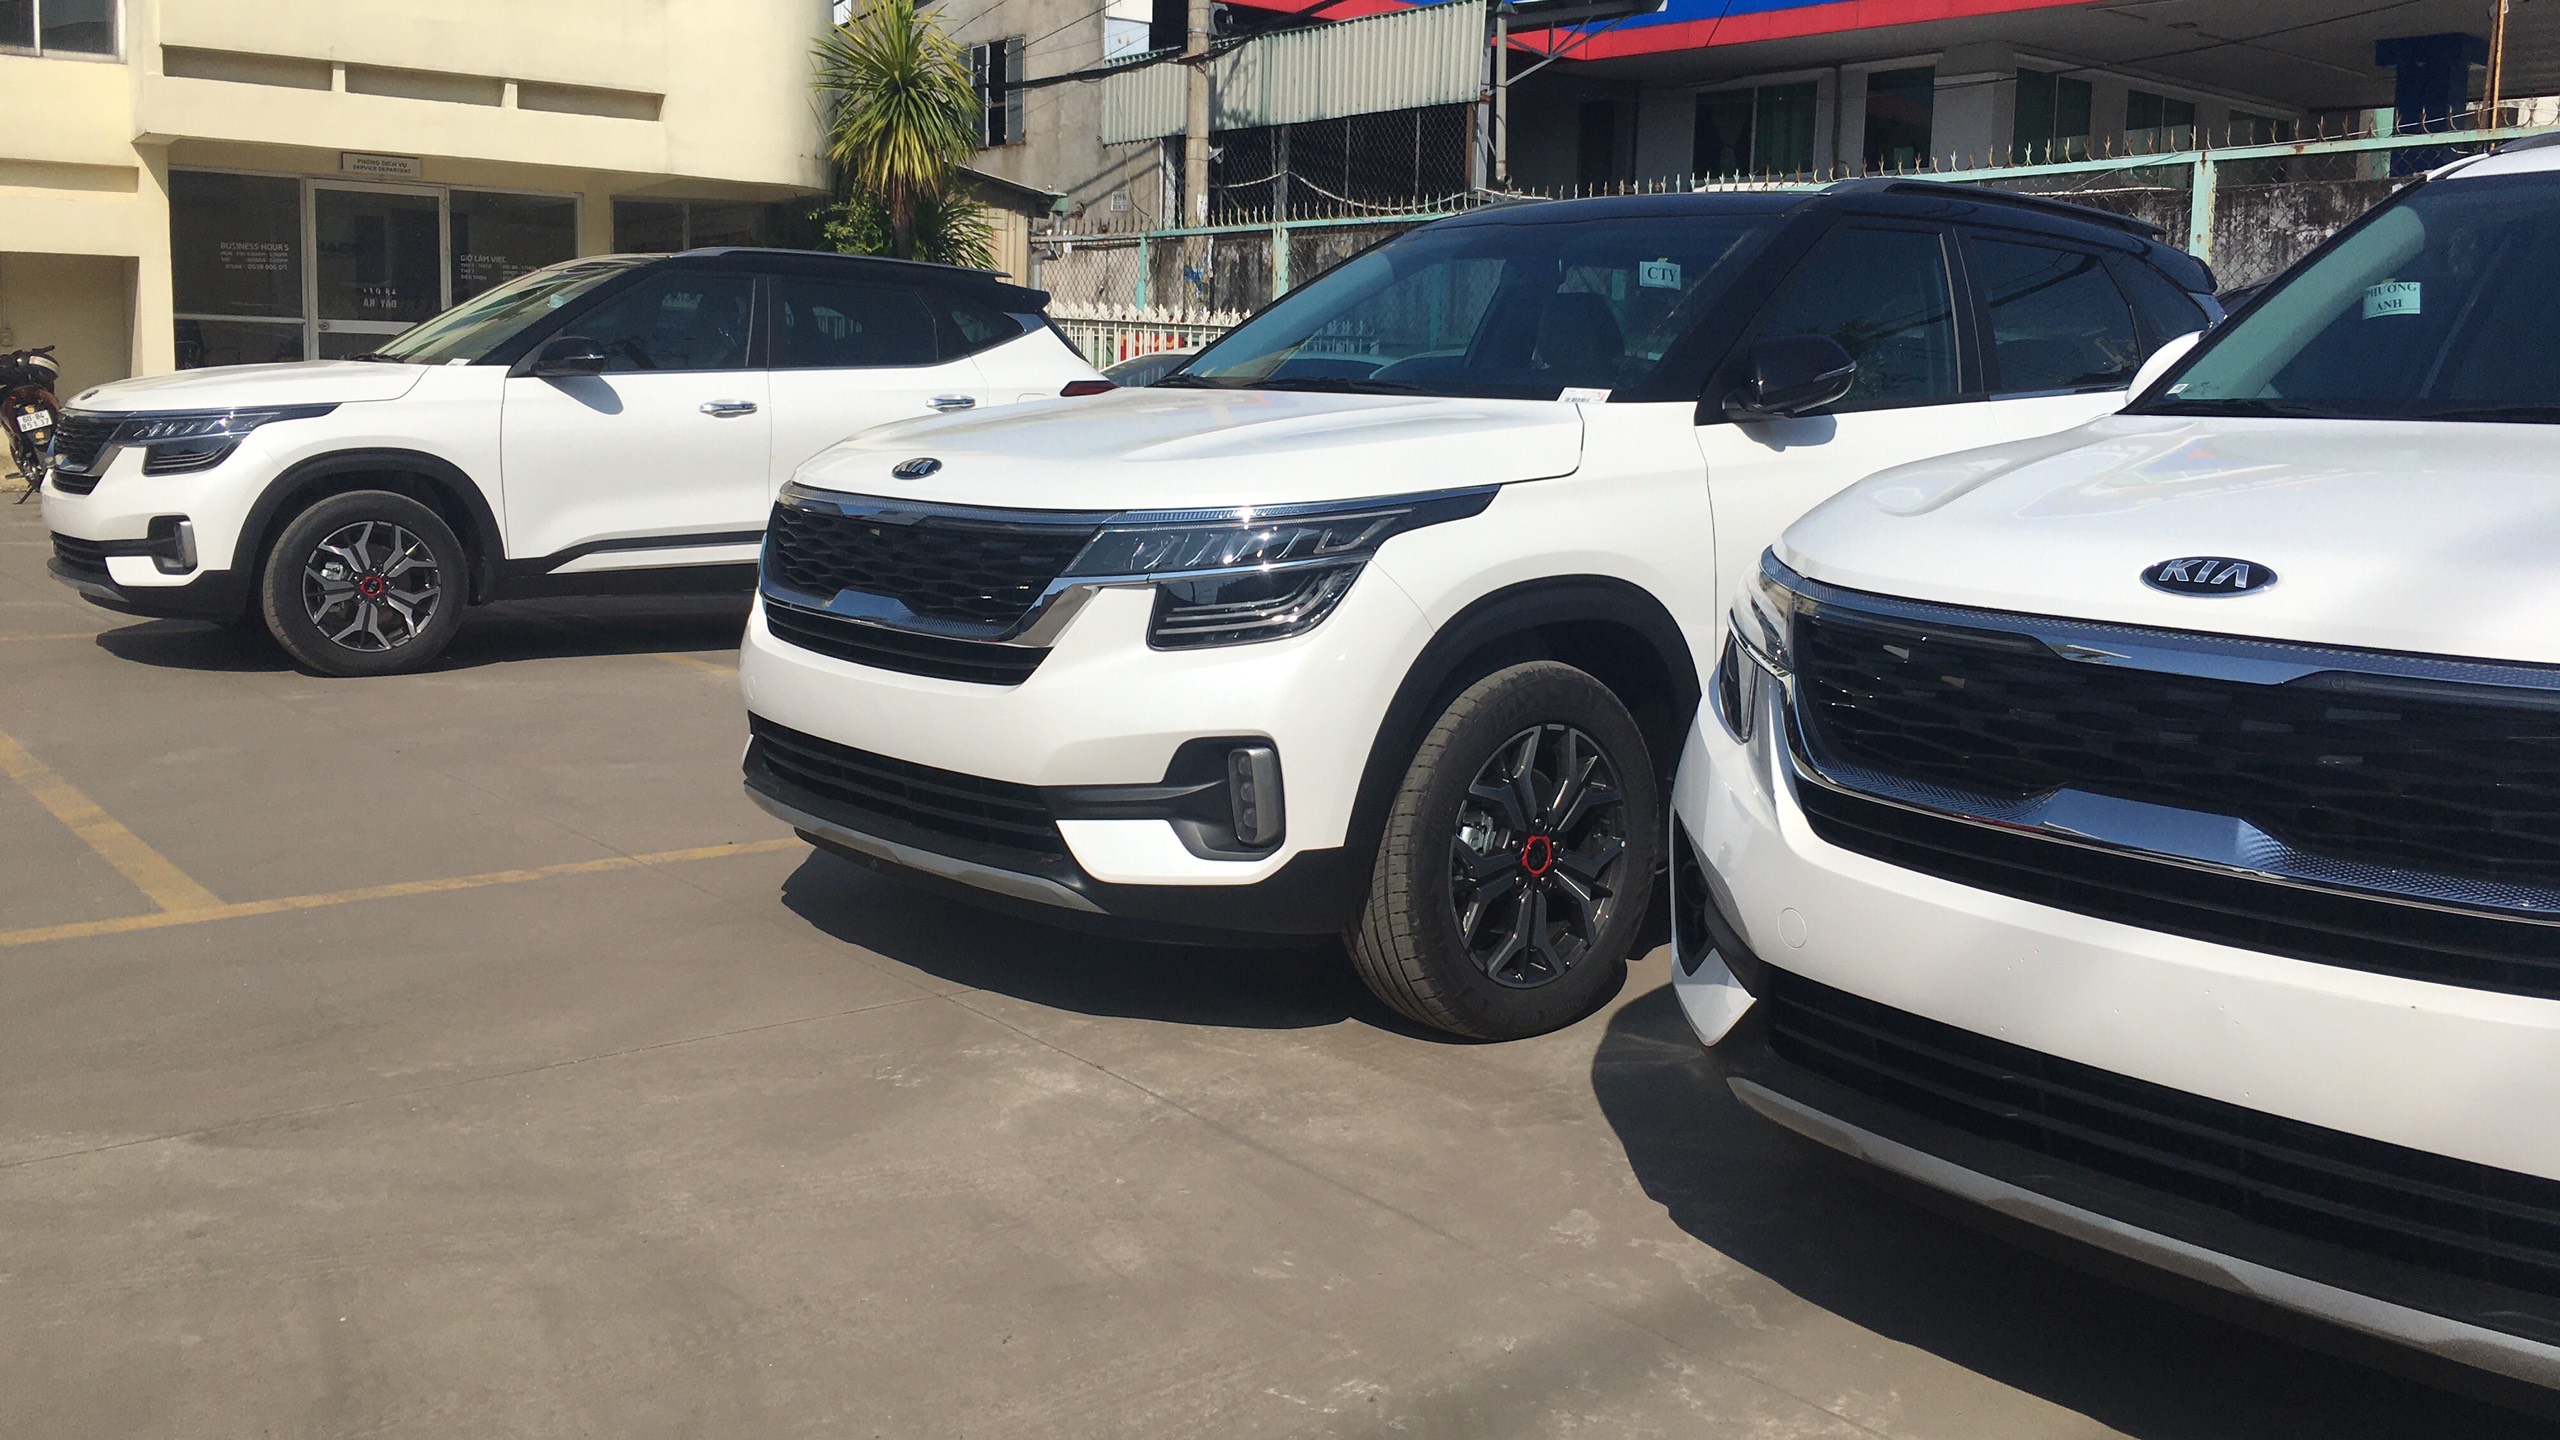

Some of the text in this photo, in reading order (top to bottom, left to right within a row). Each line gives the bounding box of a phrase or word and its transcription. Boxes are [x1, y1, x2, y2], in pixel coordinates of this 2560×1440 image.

[220, 242, 289, 251] BUSINESS HOURS
[1647, 266, 1678, 282] CTY
[2376, 299, 2402, 311] ANH
[2158, 559, 2250, 589] KIA
